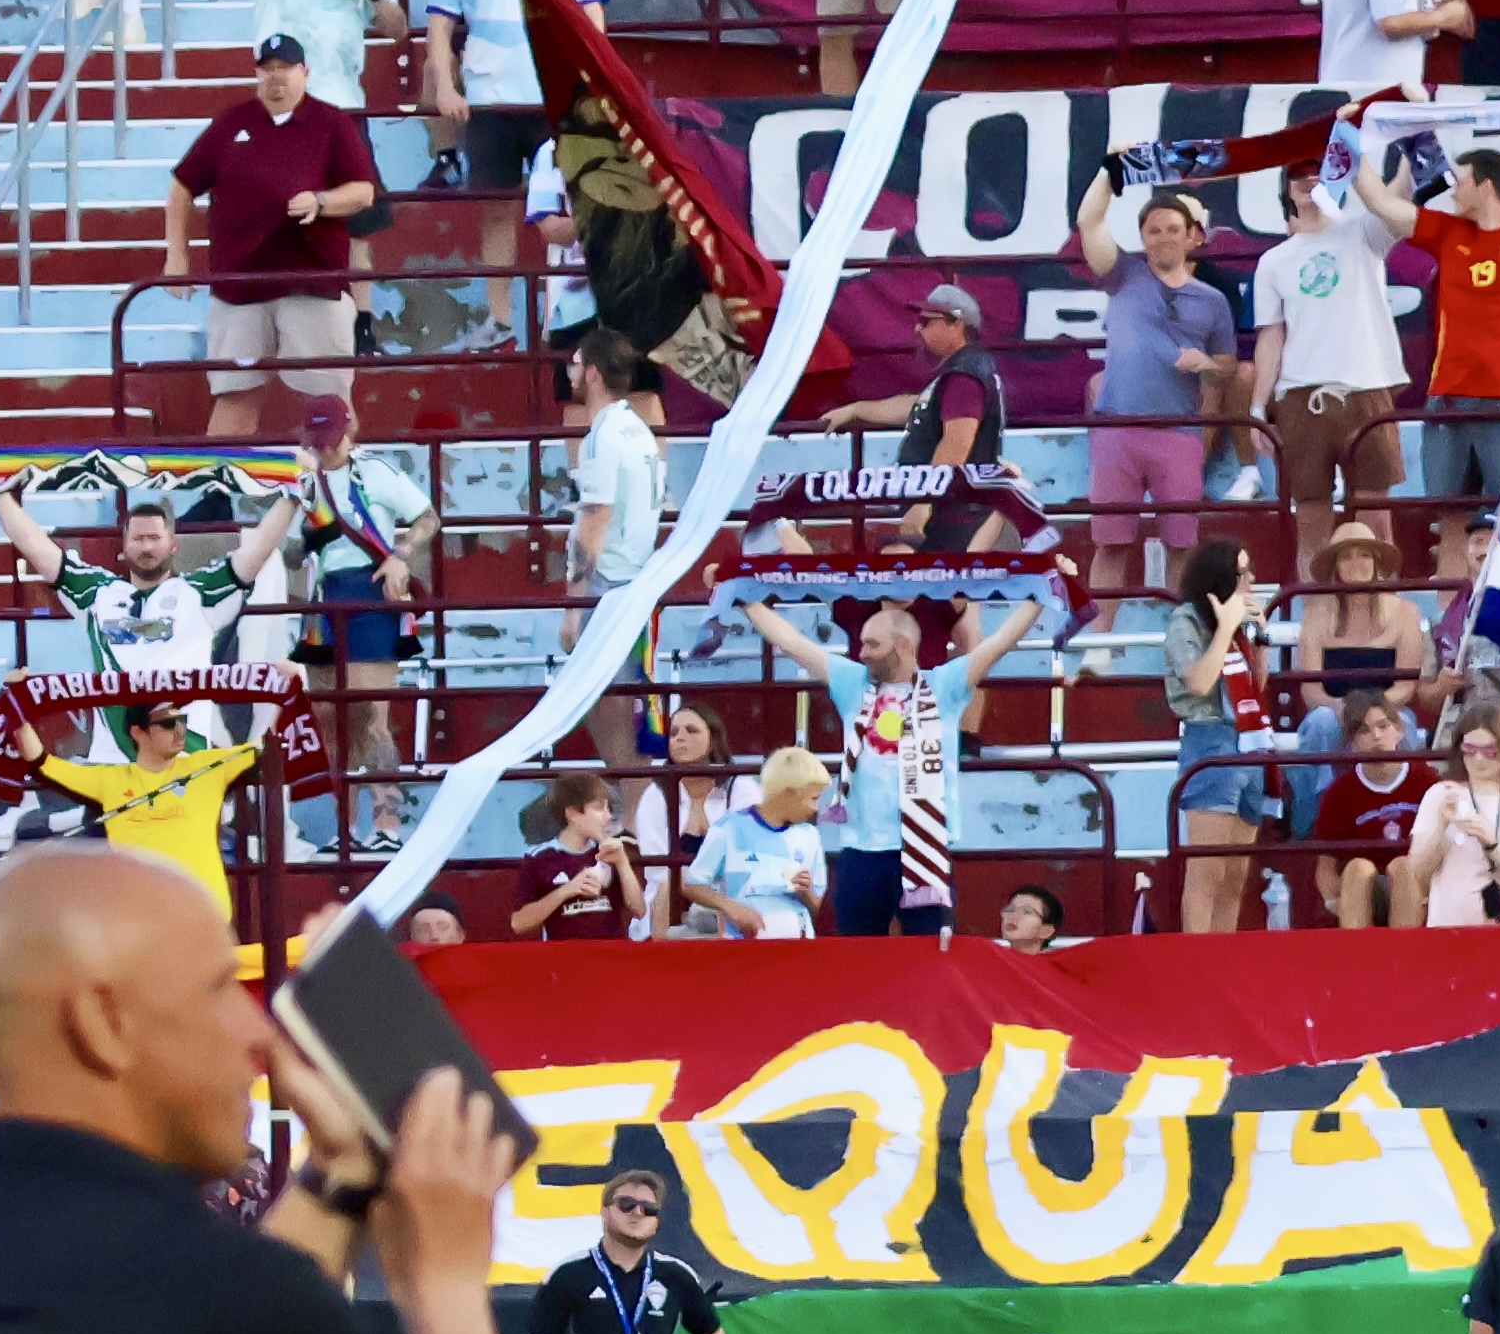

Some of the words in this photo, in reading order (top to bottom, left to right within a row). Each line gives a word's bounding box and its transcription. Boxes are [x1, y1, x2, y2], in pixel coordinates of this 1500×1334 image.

[1469, 260, 1497, 287] 19
[803, 464, 954, 504] COLORADO
[857, 569, 894, 583] THE
[902, 569, 950, 582] HIGH
[26, 670, 121, 704] PABLO
[283, 715, 322, 761] 25
